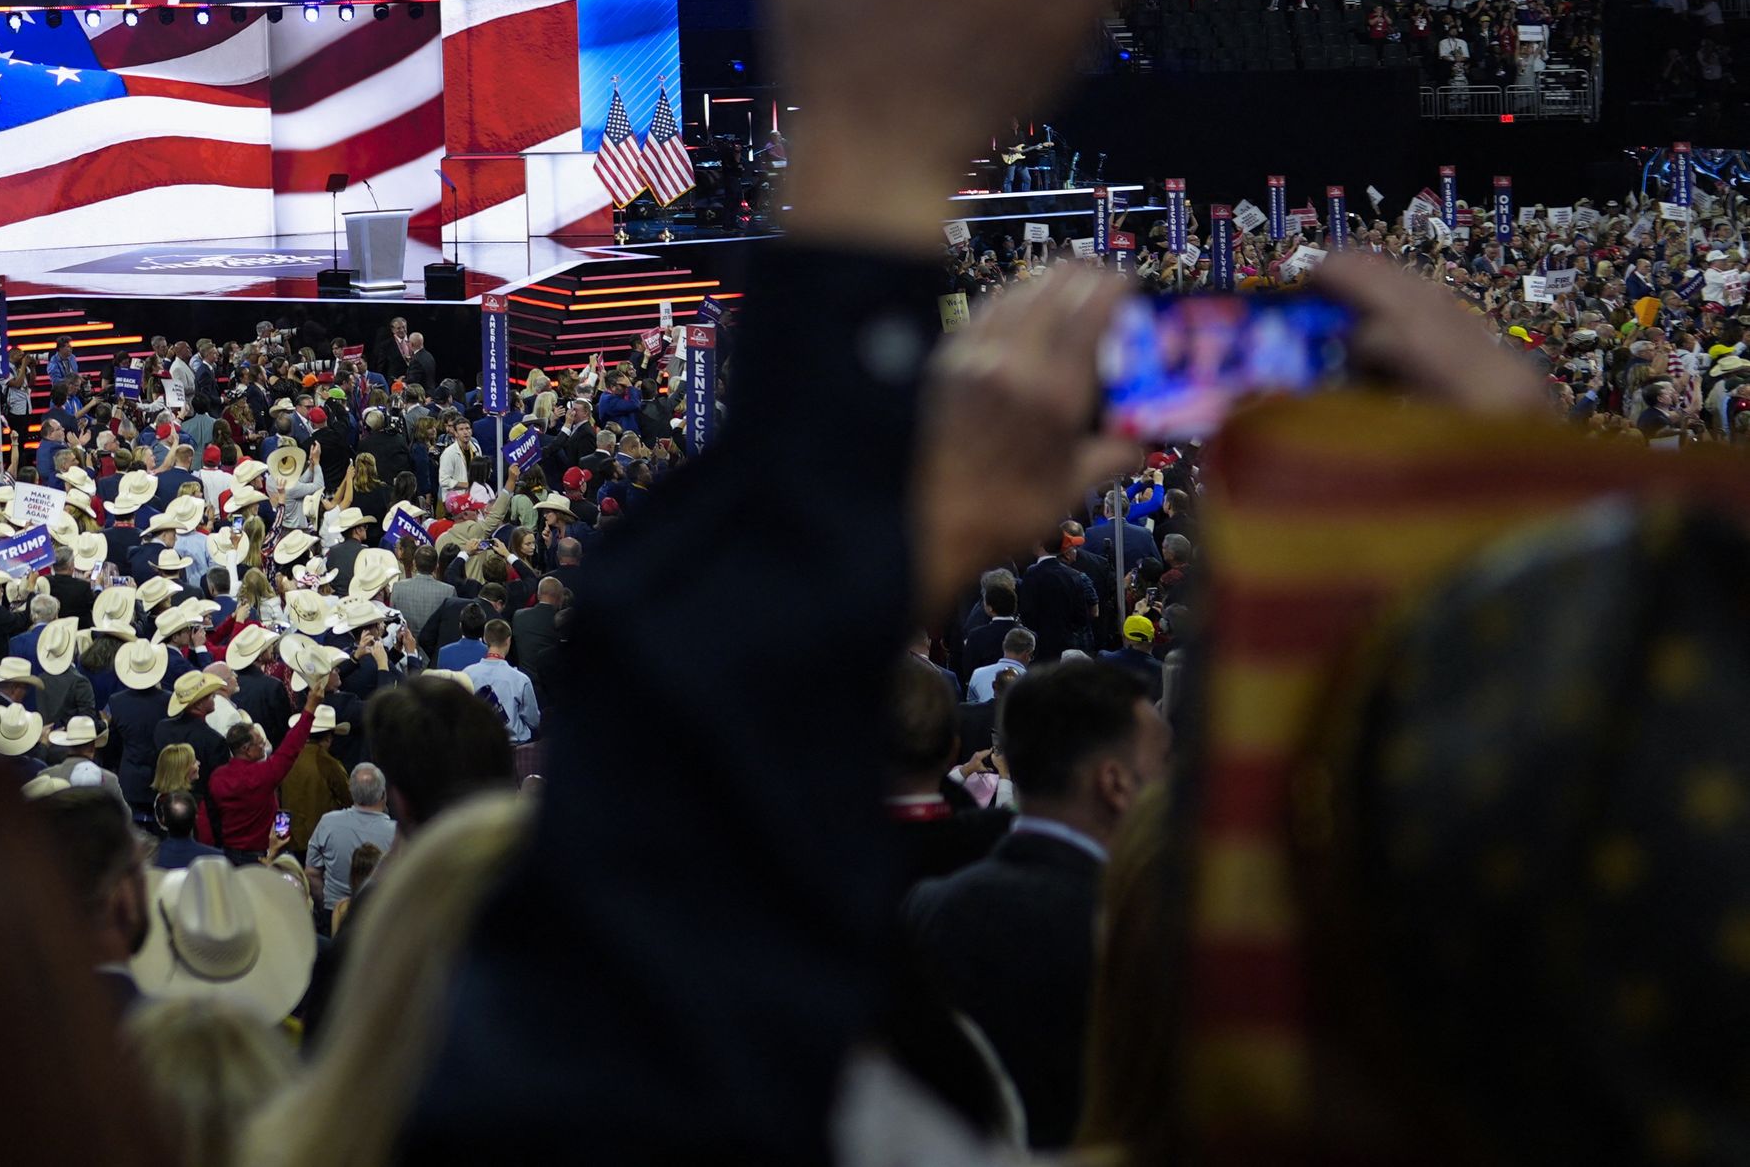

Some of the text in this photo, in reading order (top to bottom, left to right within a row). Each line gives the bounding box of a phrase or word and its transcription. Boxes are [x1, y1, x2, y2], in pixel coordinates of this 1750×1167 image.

[1097, 198, 1105, 251] NEBRASKA
[1169, 191, 1178, 251] WISCONSIN
[1498, 194, 1510, 234] OHIO
[694, 350, 706, 455] KENTUCKY
[508, 435, 537, 462] TRUMP
[24, 496, 55, 508] AMERICA
[27, 503, 50, 513] GREAT
[31, 491, 51, 500] MAKE
[0, 535, 47, 561] TRUMP
